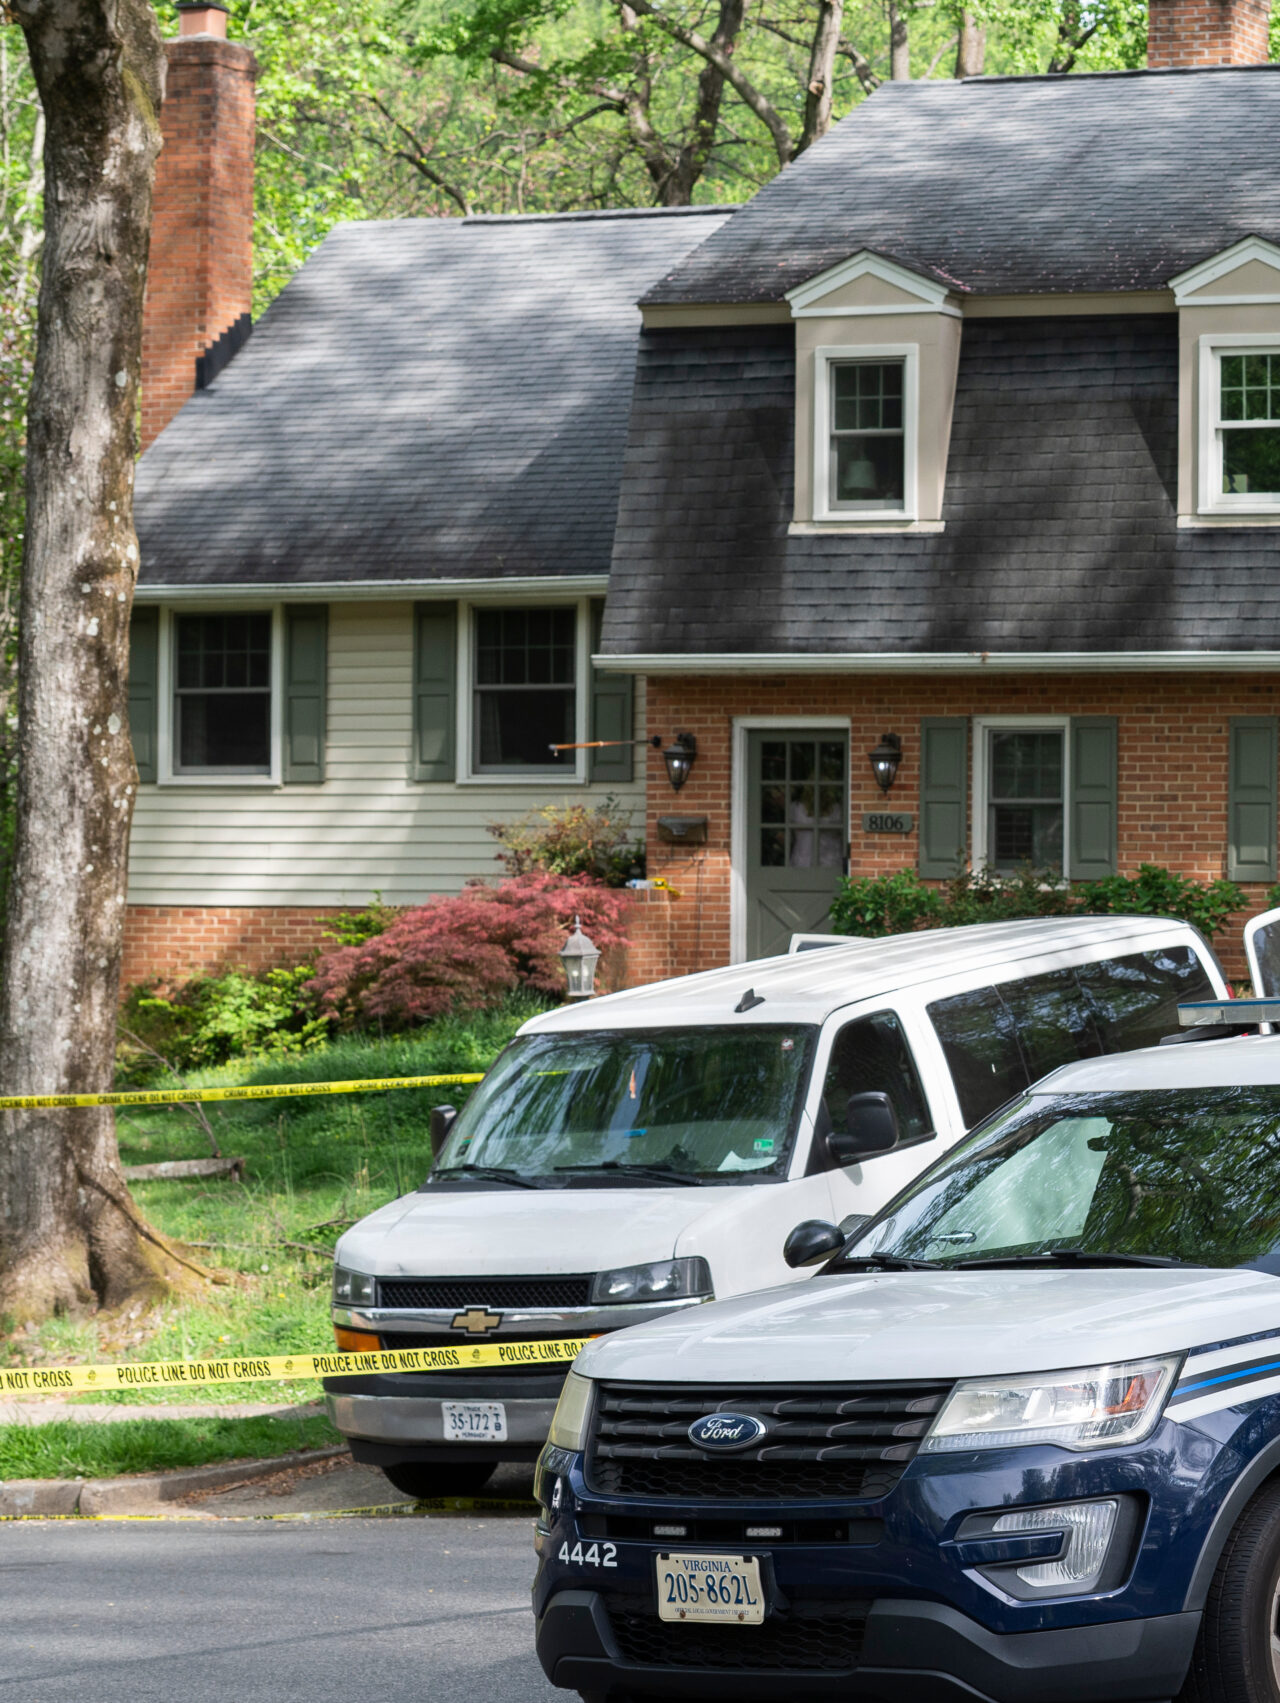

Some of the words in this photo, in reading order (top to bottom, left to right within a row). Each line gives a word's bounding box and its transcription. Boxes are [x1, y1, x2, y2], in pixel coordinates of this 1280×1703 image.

[868, 815, 904, 830] 8106
[312, 1355, 353, 1373] POLICE
[354, 1354, 380, 1371] LINE
[381, 1353, 397, 1370] DO
[398, 1352, 422, 1368] NOT
[423, 1349, 460, 1367] CROSS
[498, 1345, 538, 1362] POLICE
[538, 1343, 563, 1358] LINE
[563, 1342, 580, 1357] DO
[6, 1372, 30, 1389] NOT
[33, 1370, 73, 1388] CROSS
[116, 1366, 160, 1384] POLICE
[160, 1364, 188, 1382] LINE
[189, 1363, 206, 1380] DO
[207, 1362, 231, 1379] NOT
[233, 1360, 272, 1378] CROSS
[450, 1413, 489, 1430] 35-172
[701, 1418, 744, 1439] Ford
[558, 1541, 618, 1567] 4442
[682, 1560, 732, 1572] VIRGINIA
[665, 1573, 757, 1605] 205-862L
